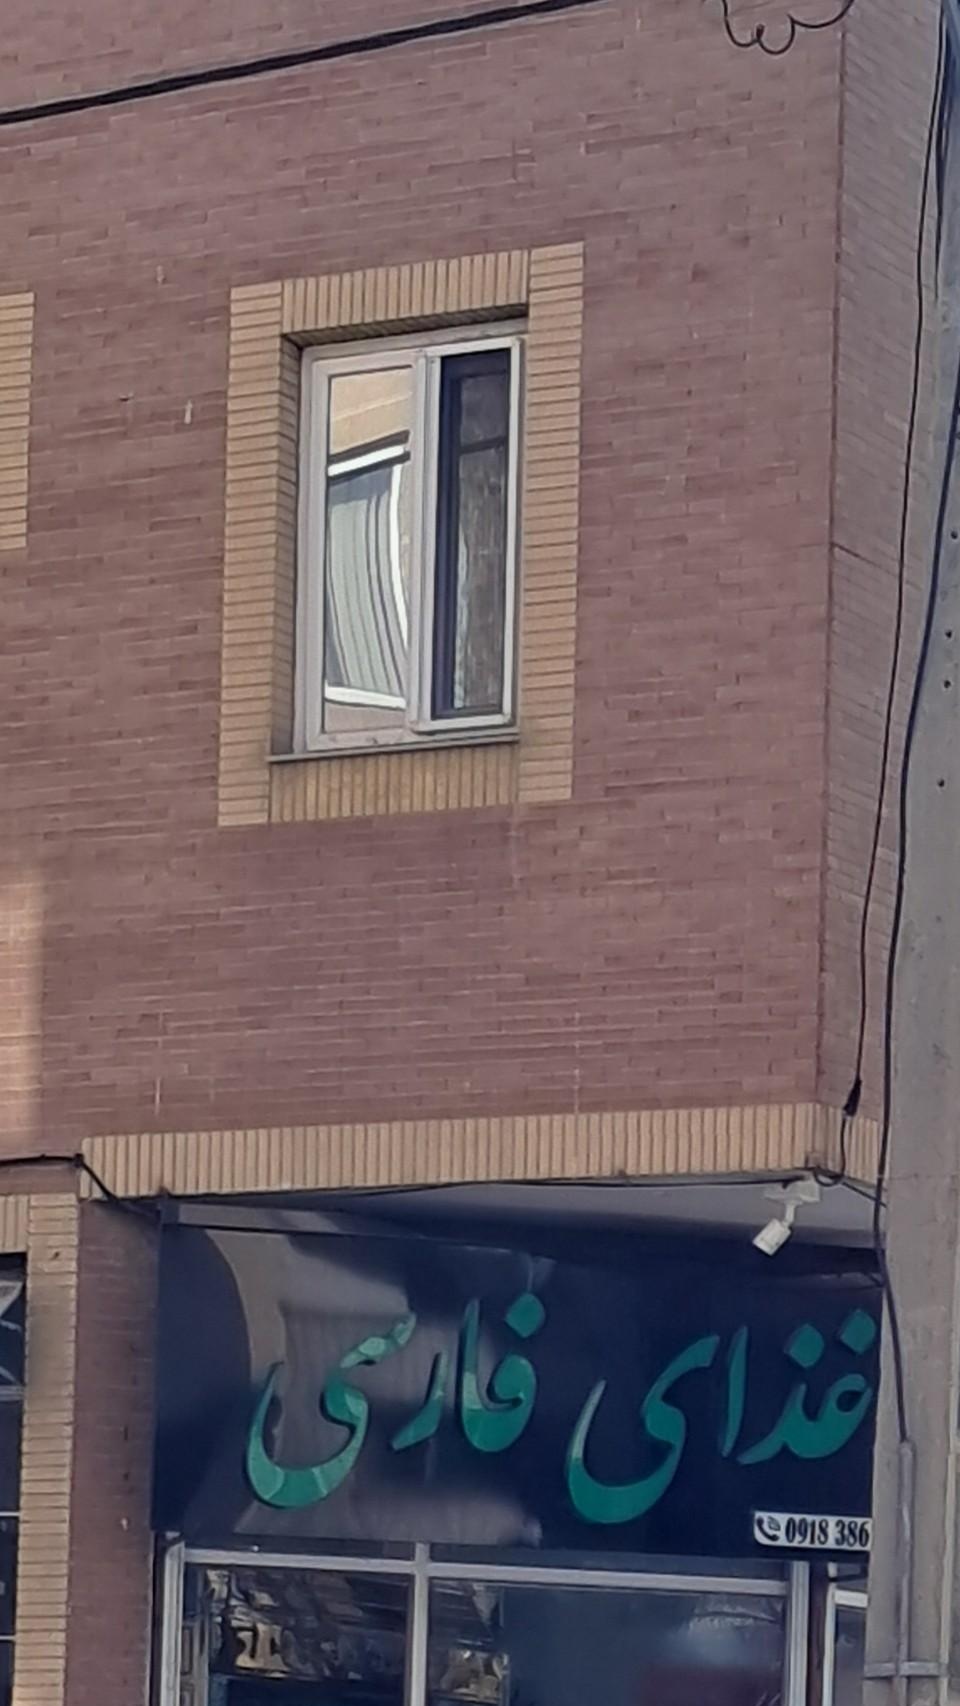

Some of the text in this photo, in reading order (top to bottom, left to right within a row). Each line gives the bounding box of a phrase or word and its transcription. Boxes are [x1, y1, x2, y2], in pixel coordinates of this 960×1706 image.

[246, 1293, 875, 1524] غذای فارسی
[785, 1517, 869, 1547] 0918 386
